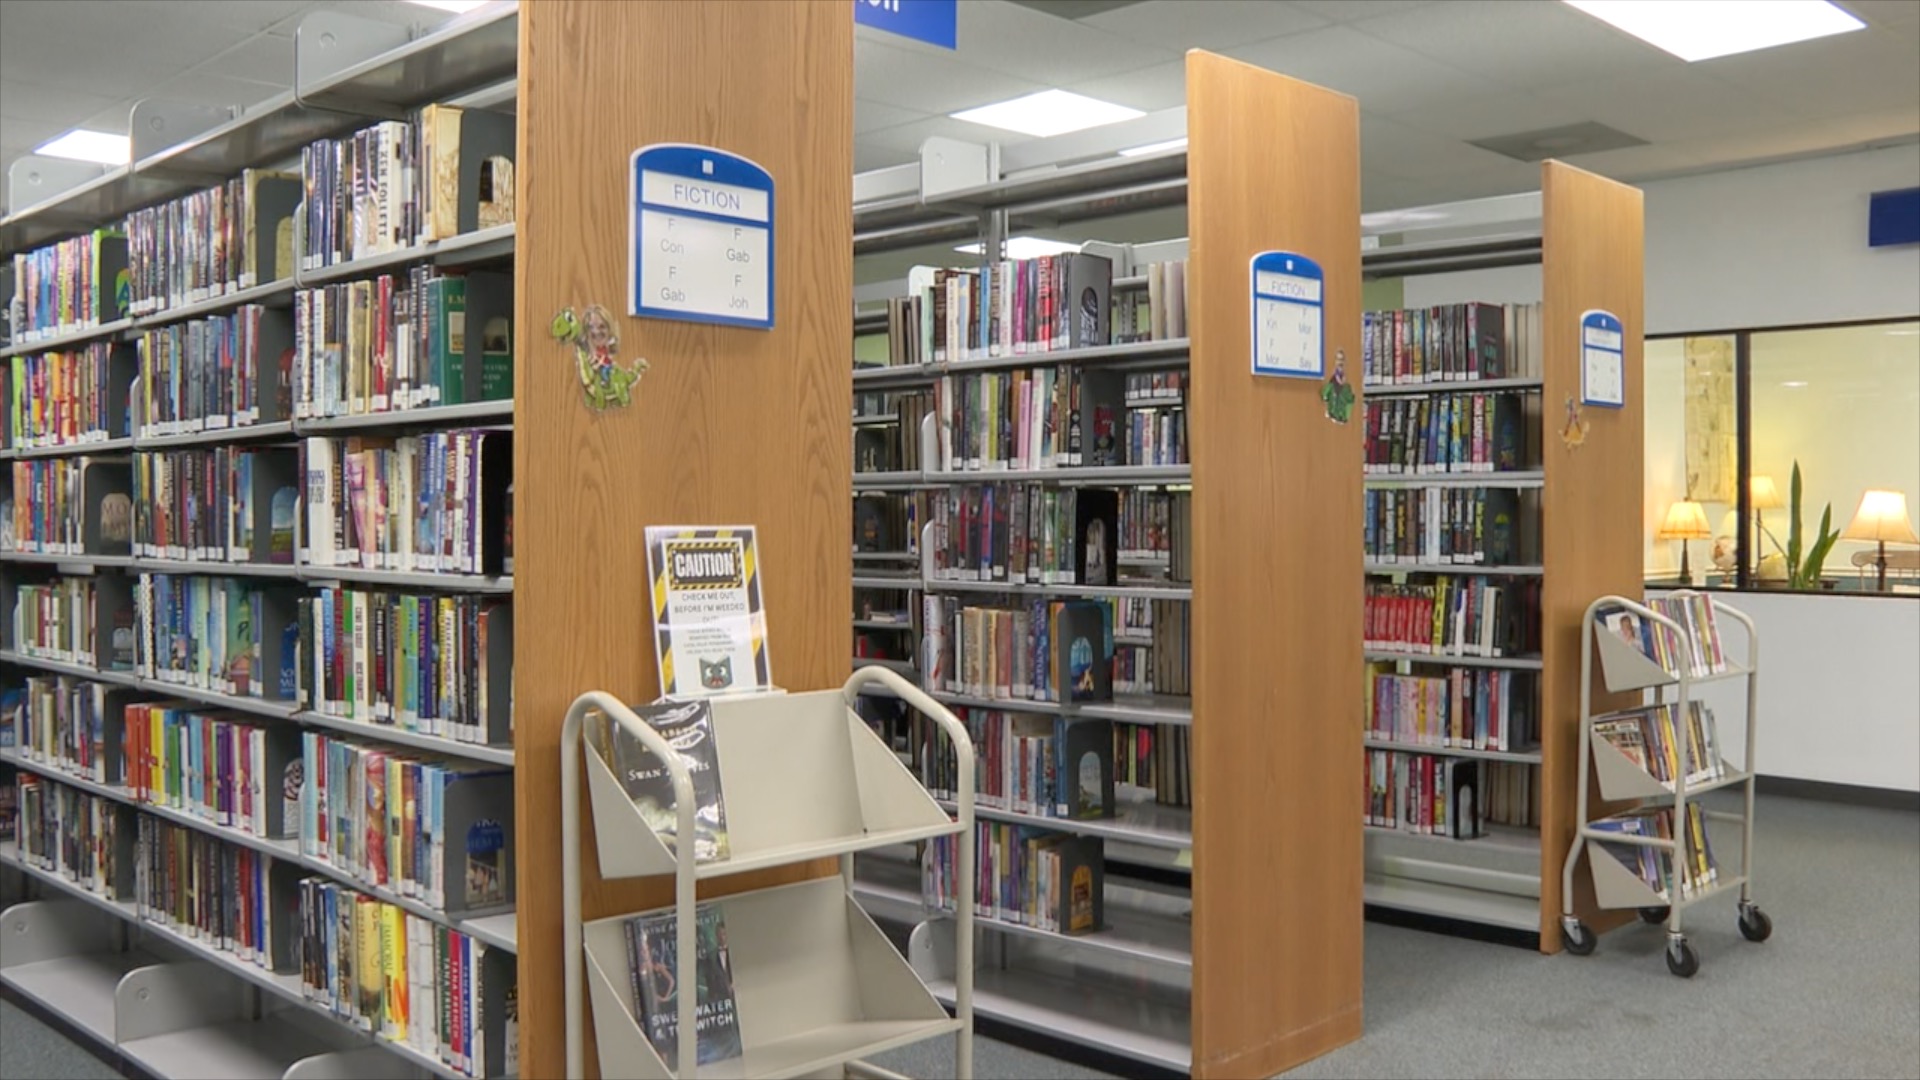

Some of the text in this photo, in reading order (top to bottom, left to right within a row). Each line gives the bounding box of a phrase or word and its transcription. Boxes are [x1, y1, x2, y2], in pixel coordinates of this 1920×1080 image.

[674, 183, 741, 211] FICTION
[379, 182, 389, 237] FOLLETT
[668, 218, 676, 231] F
[734, 228, 742, 241] F
[660, 239, 685, 255] Con
[726, 248, 750, 263] Gab
[668, 266, 677, 279] F
[734, 274, 742, 288] F
[1271, 281, 1306, 297] FICTION
[660, 287, 686, 303] Gab
[728, 296, 749, 310] Joh
[675, 551, 735, 578] CAUTION
[682, 592, 706, 601] CHECK
[707, 592, 718, 601] ME
[674, 602, 745, 613] BEFORE I'M WEEDED
[451, 961, 459, 990] TANA
[443, 957, 451, 1034] TANA FRENCH
[696, 1014, 734, 1031] WITCH
